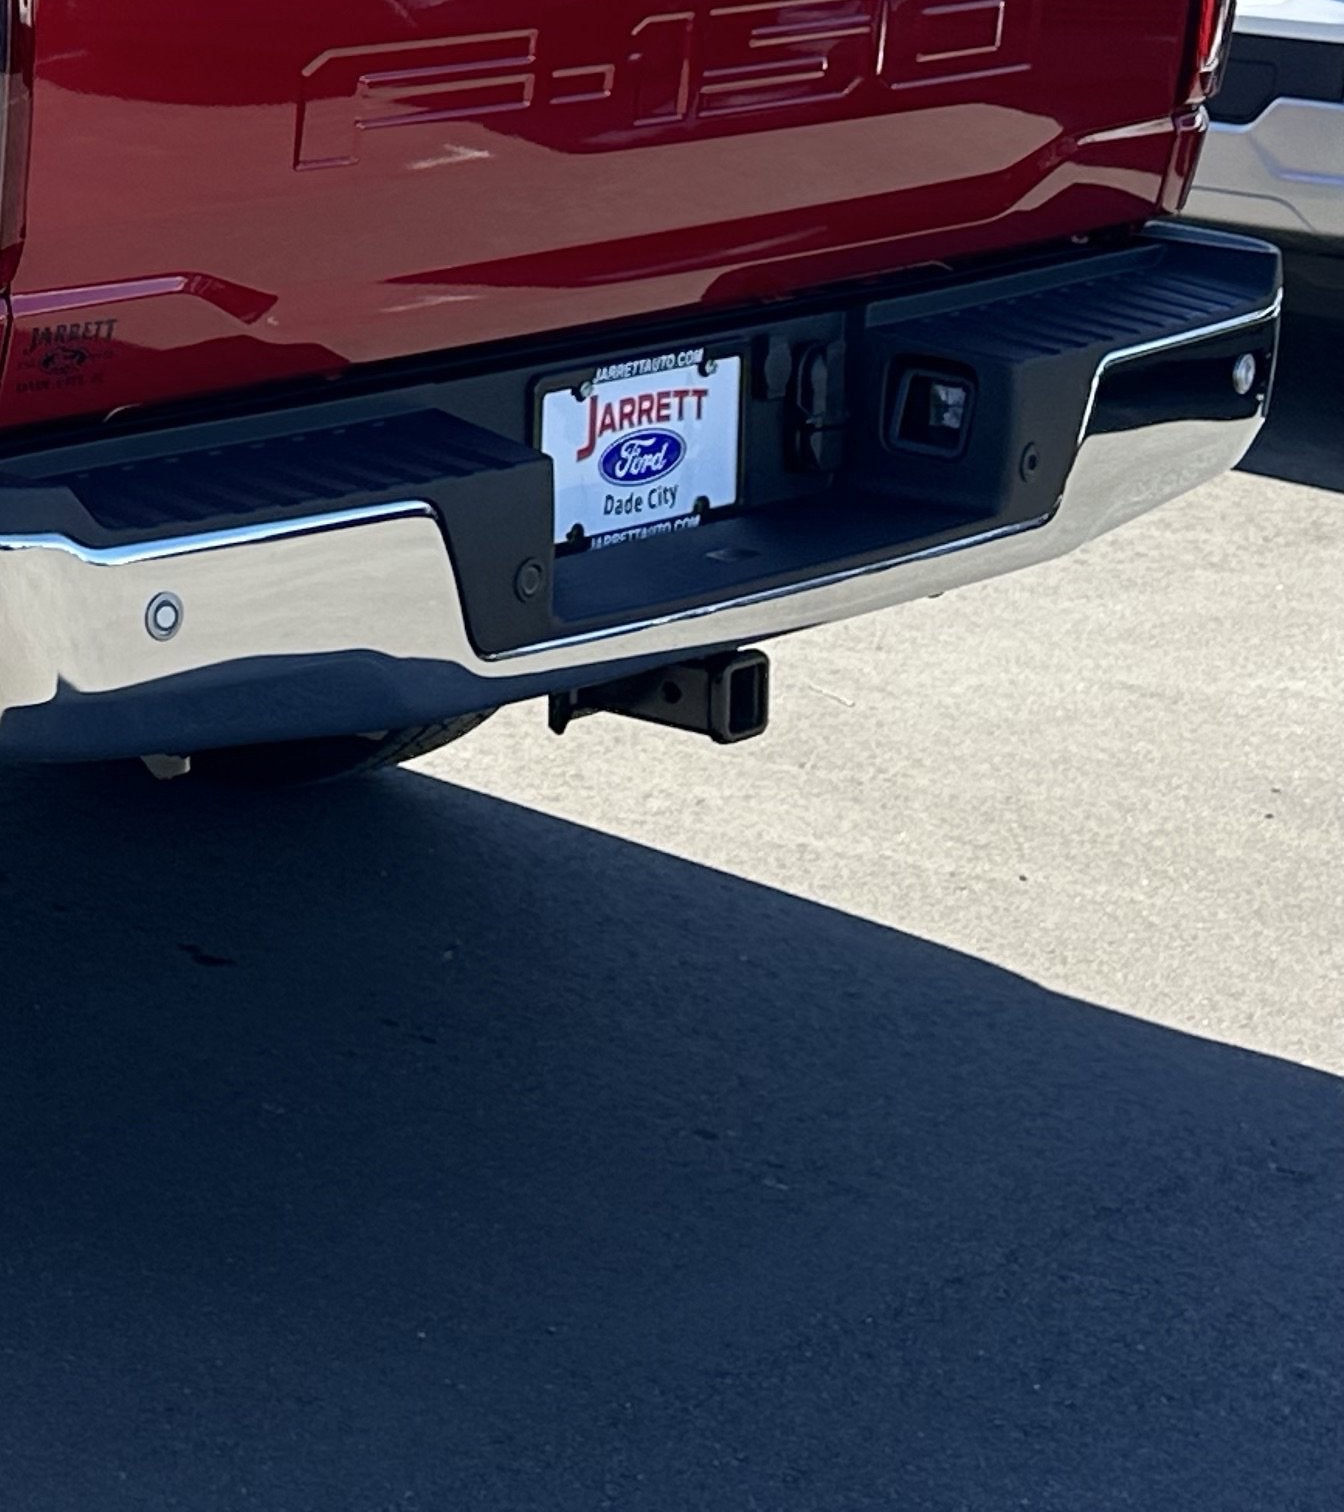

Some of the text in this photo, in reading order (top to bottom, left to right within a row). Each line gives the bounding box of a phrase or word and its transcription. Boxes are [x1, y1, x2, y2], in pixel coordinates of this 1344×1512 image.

[592, 346, 705, 384] JARRETTAUTO.COM
[576, 388, 709, 463] JARRETT
[614, 437, 669, 479] Ford
[603, 484, 679, 516] Dade City
